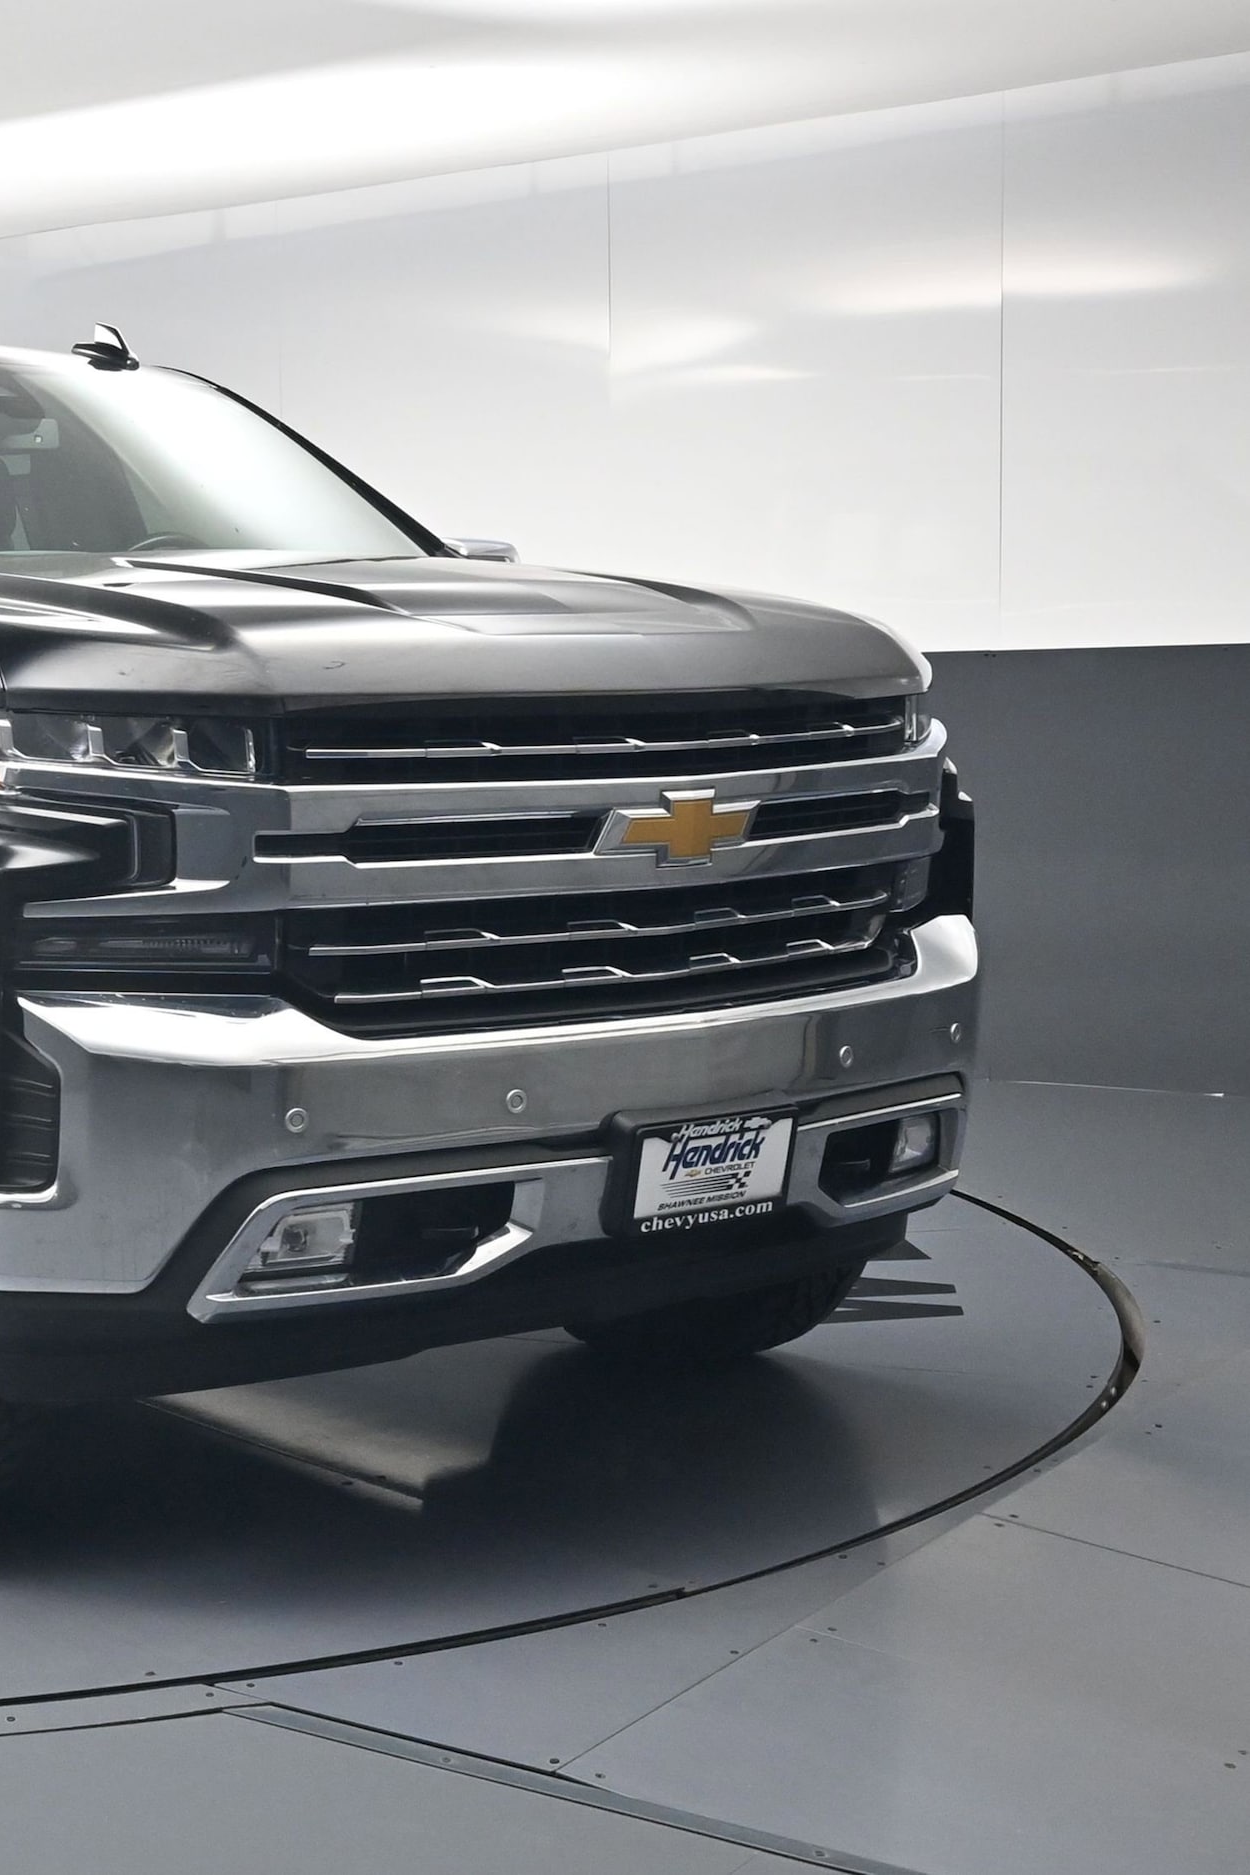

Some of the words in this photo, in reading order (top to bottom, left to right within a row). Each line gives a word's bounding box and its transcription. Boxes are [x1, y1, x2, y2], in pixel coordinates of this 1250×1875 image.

[677, 1117, 743, 1139] Hendrick
[662, 1130, 766, 1180] Hendrick
[704, 1161, 756, 1175] CHEVROLET
[657, 1196, 704, 1211] SHAWNEE
[706, 1190, 747, 1205] MISSION
[640, 1200, 773, 1233] chevyusa.com
